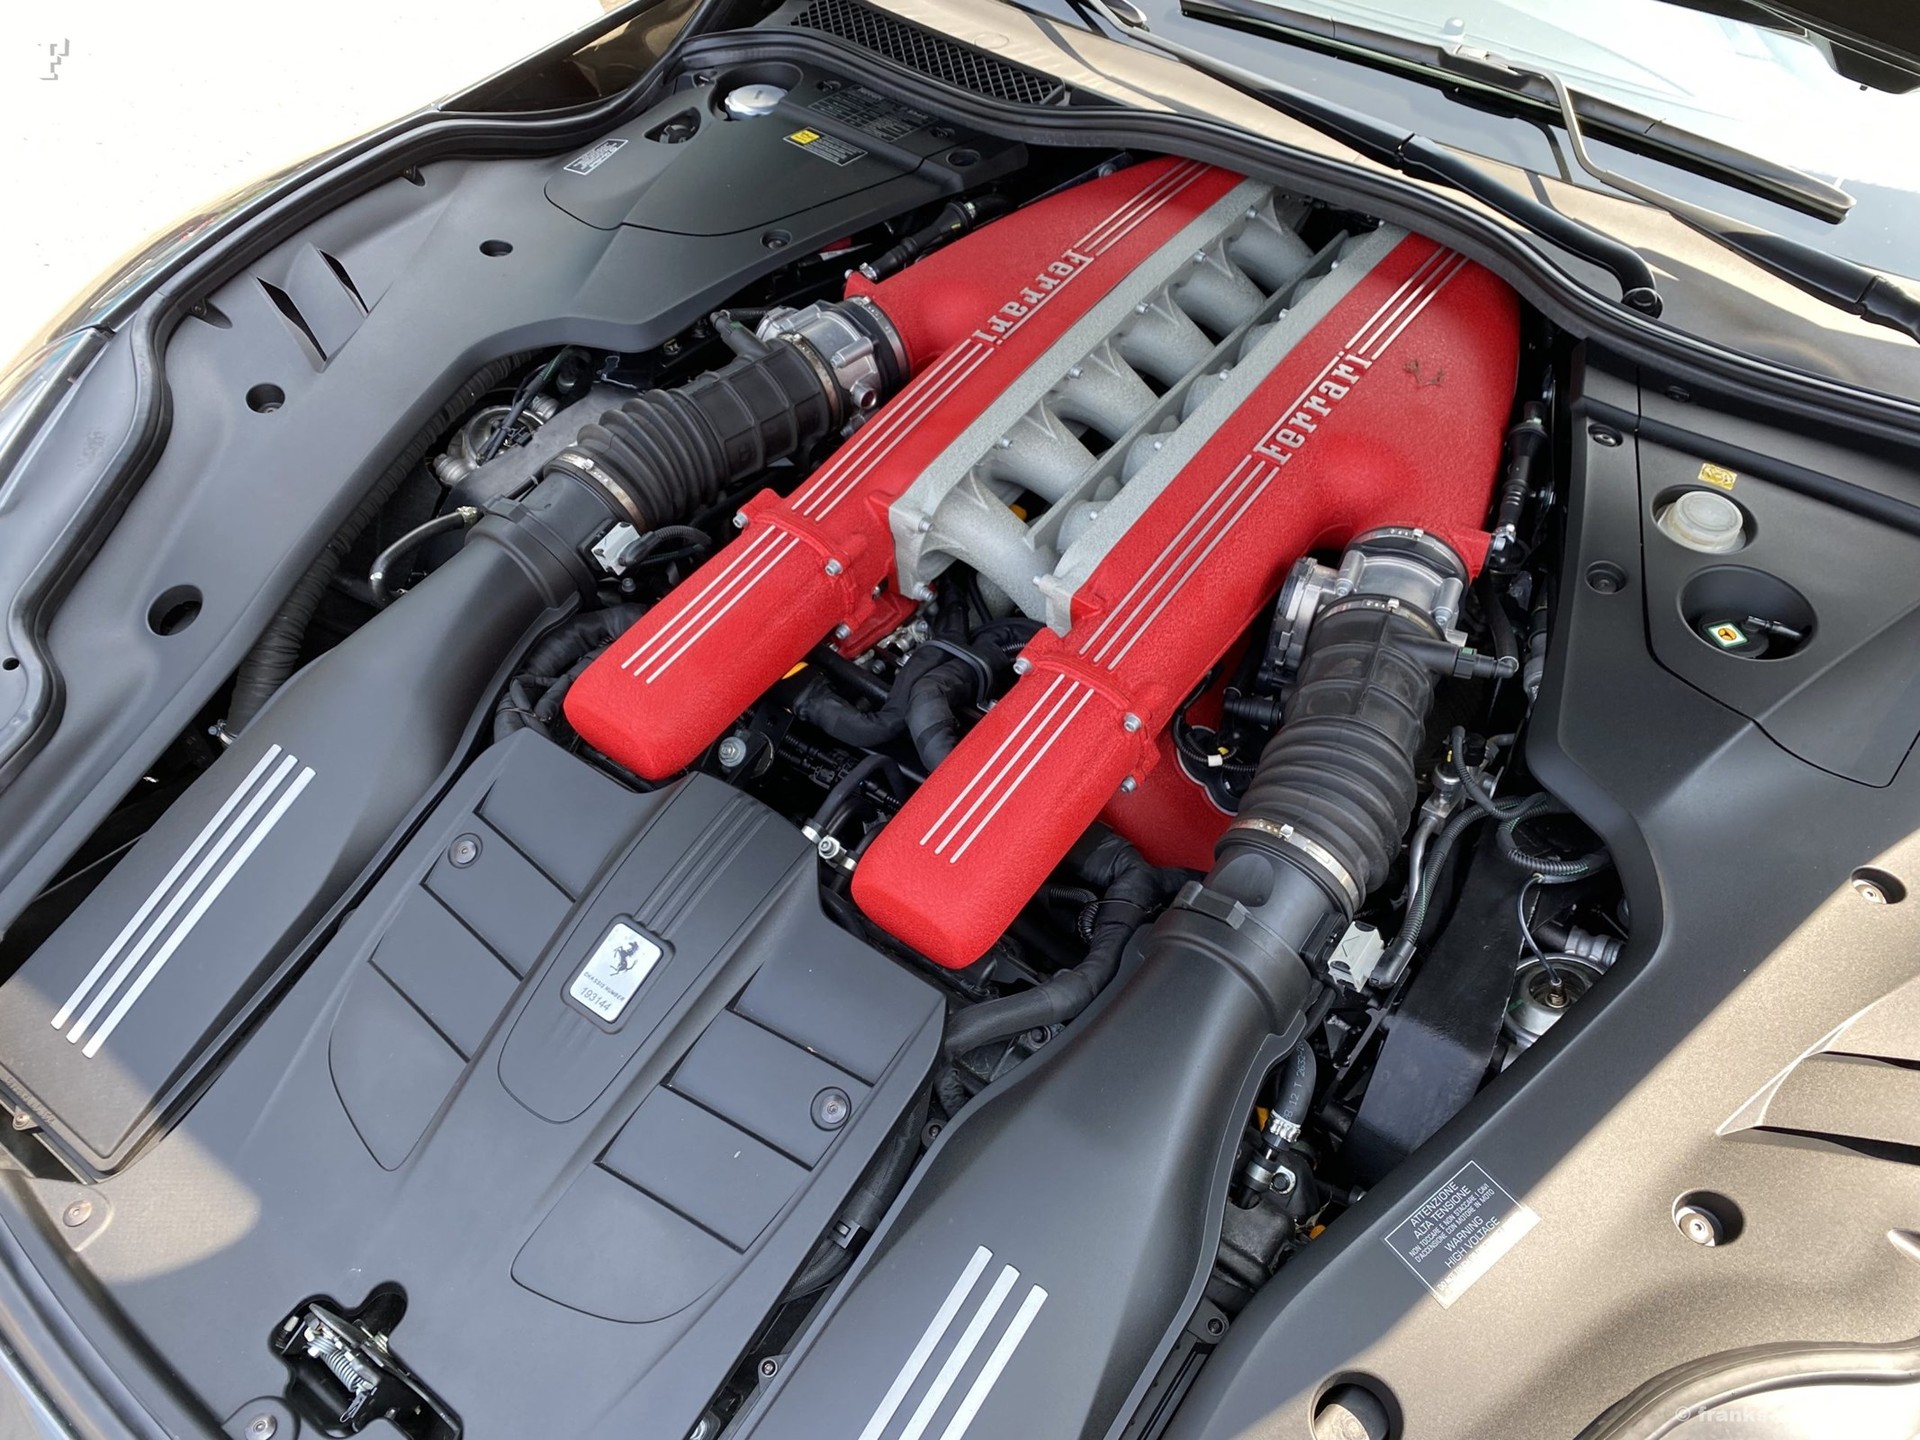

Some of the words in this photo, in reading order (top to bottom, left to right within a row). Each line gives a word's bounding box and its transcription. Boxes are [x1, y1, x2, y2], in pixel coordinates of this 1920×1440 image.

[971, 248, 1095, 345] Ferrari
[1252, 350, 1373, 465] Ferrari
[580, 986, 612, 1011] 193144
[583, 971, 606, 989] CHASSIS
[604, 985, 626, 1002] NUMBER
[1289, 1094, 1299, 1106] 12
[1408, 1244, 1422, 1257] NON
[1419, 1226, 1441, 1247] TOCCARE
[1443, 1214, 1456, 1226] NON
[1453, 1194, 1477, 1217] STACCARE
[1477, 1183, 1489, 1195] CAVI
[1410, 1181, 1459, 1227] ATTENZIONE
[1413, 1220, 1434, 1240] ALTA
[1430, 1185, 1471, 1222] TENSIONE
[1445, 1222, 1458, 1234] CON
[1455, 1205, 1476, 1226] MOTORE
[1473, 1201, 1482, 1209] IN
[1479, 1188, 1495, 1203] MOTO
[1444, 1215, 1484, 1252] WARNING
[1444, 1246, 1468, 1269] HIGH
[1464, 1216, 1500, 1249] VOLTAGE
